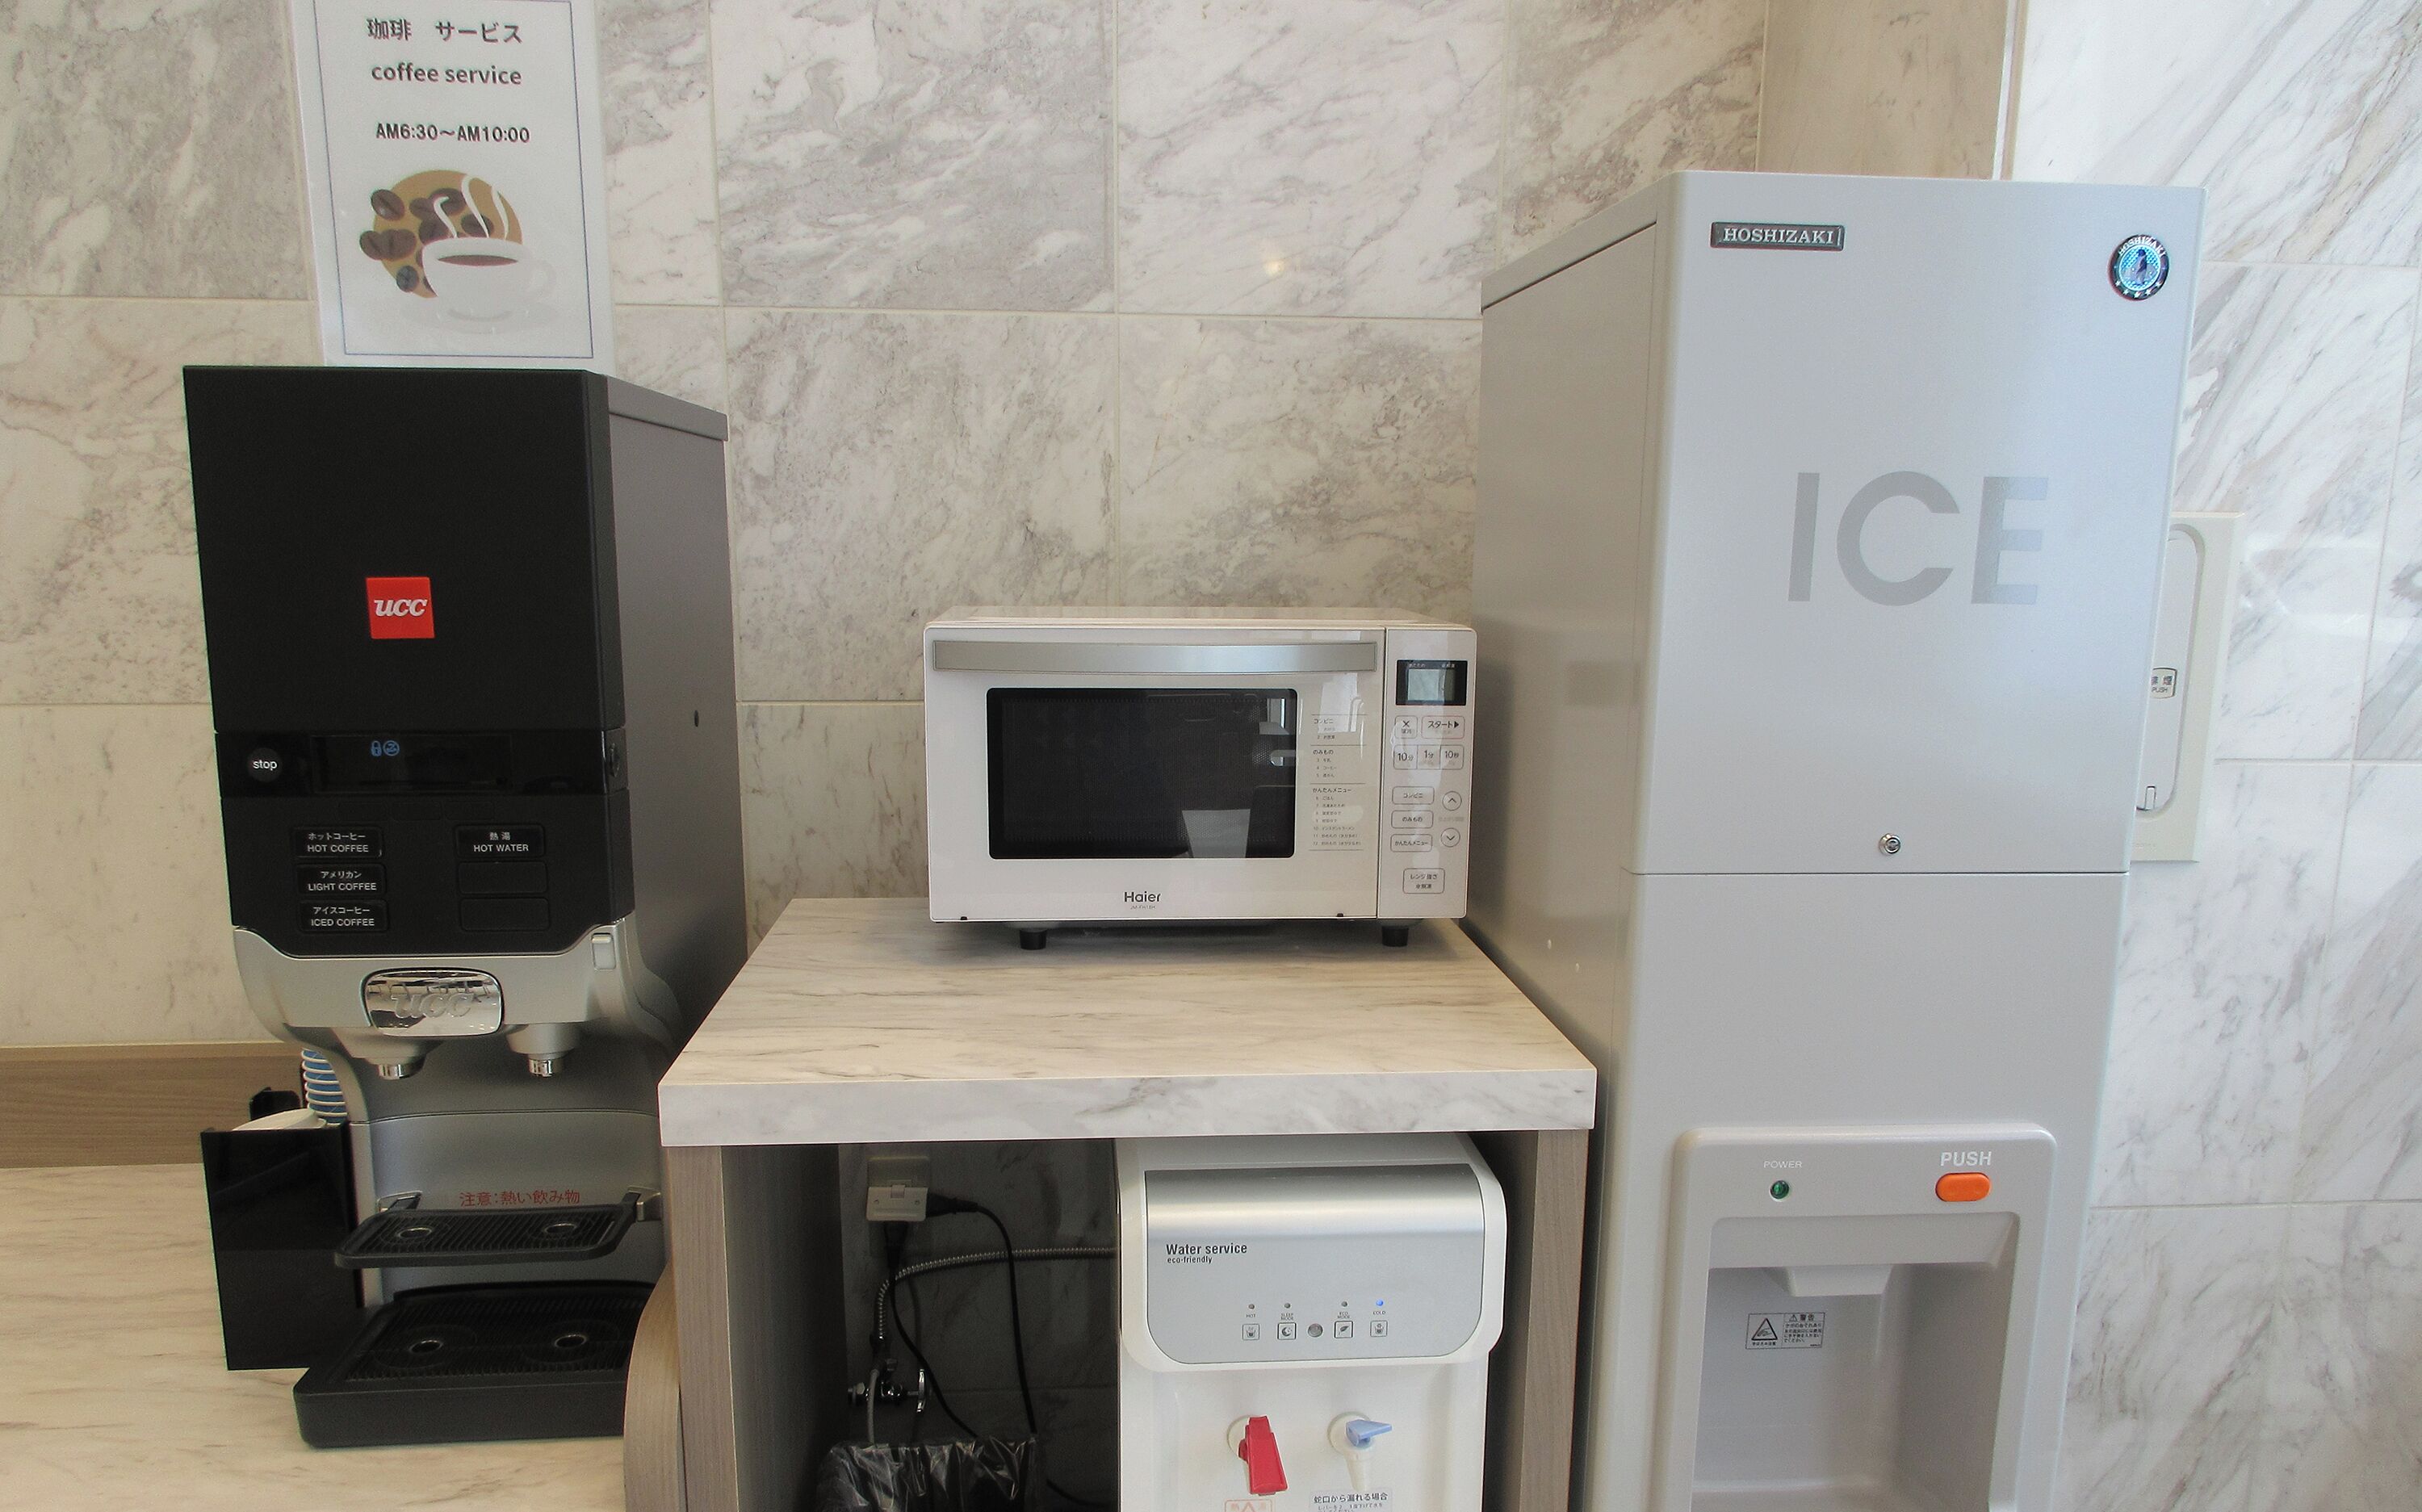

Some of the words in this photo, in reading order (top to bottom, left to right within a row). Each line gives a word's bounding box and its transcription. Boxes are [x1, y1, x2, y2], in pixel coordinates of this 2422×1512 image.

[367, 18, 413, 41] 珈琲
[435, 21, 522, 44] サービス
[371, 62, 439, 82] coffee
[445, 65, 522, 85] service
[1723, 228, 1833, 245] HOSHIZAKI
[2118, 236, 2166, 258] HOSHIZAKI
[1787, 471, 2049, 607] ICE
[1427, 720, 1454, 729] スタート
[253, 760, 278, 771] stop
[308, 832, 367, 841] ホットコーヒー
[308, 844, 328, 852] HOT
[330, 844, 369, 852] COFFEE
[473, 844, 493, 852] HOT
[496, 844, 529, 852] WATER
[321, 871, 362, 879] アメリカン
[308, 883, 336, 891] LIGHT
[338, 882, 377, 890] COFFEE
[1124, 891, 1161, 903] Haier
[313, 907, 371, 915] アイスコーヒー
[311, 919, 334, 927] ICED
[337, 919, 375, 927] COFFEE
[1940, 1150, 1992, 1167] PUSH
[1763, 1160, 1803, 1169] POWER
[1166, 1243, 1202, 1254] Water
[1205, 1242, 1247, 1254] service
[1167, 1256, 1212, 1264] eco-friendly
